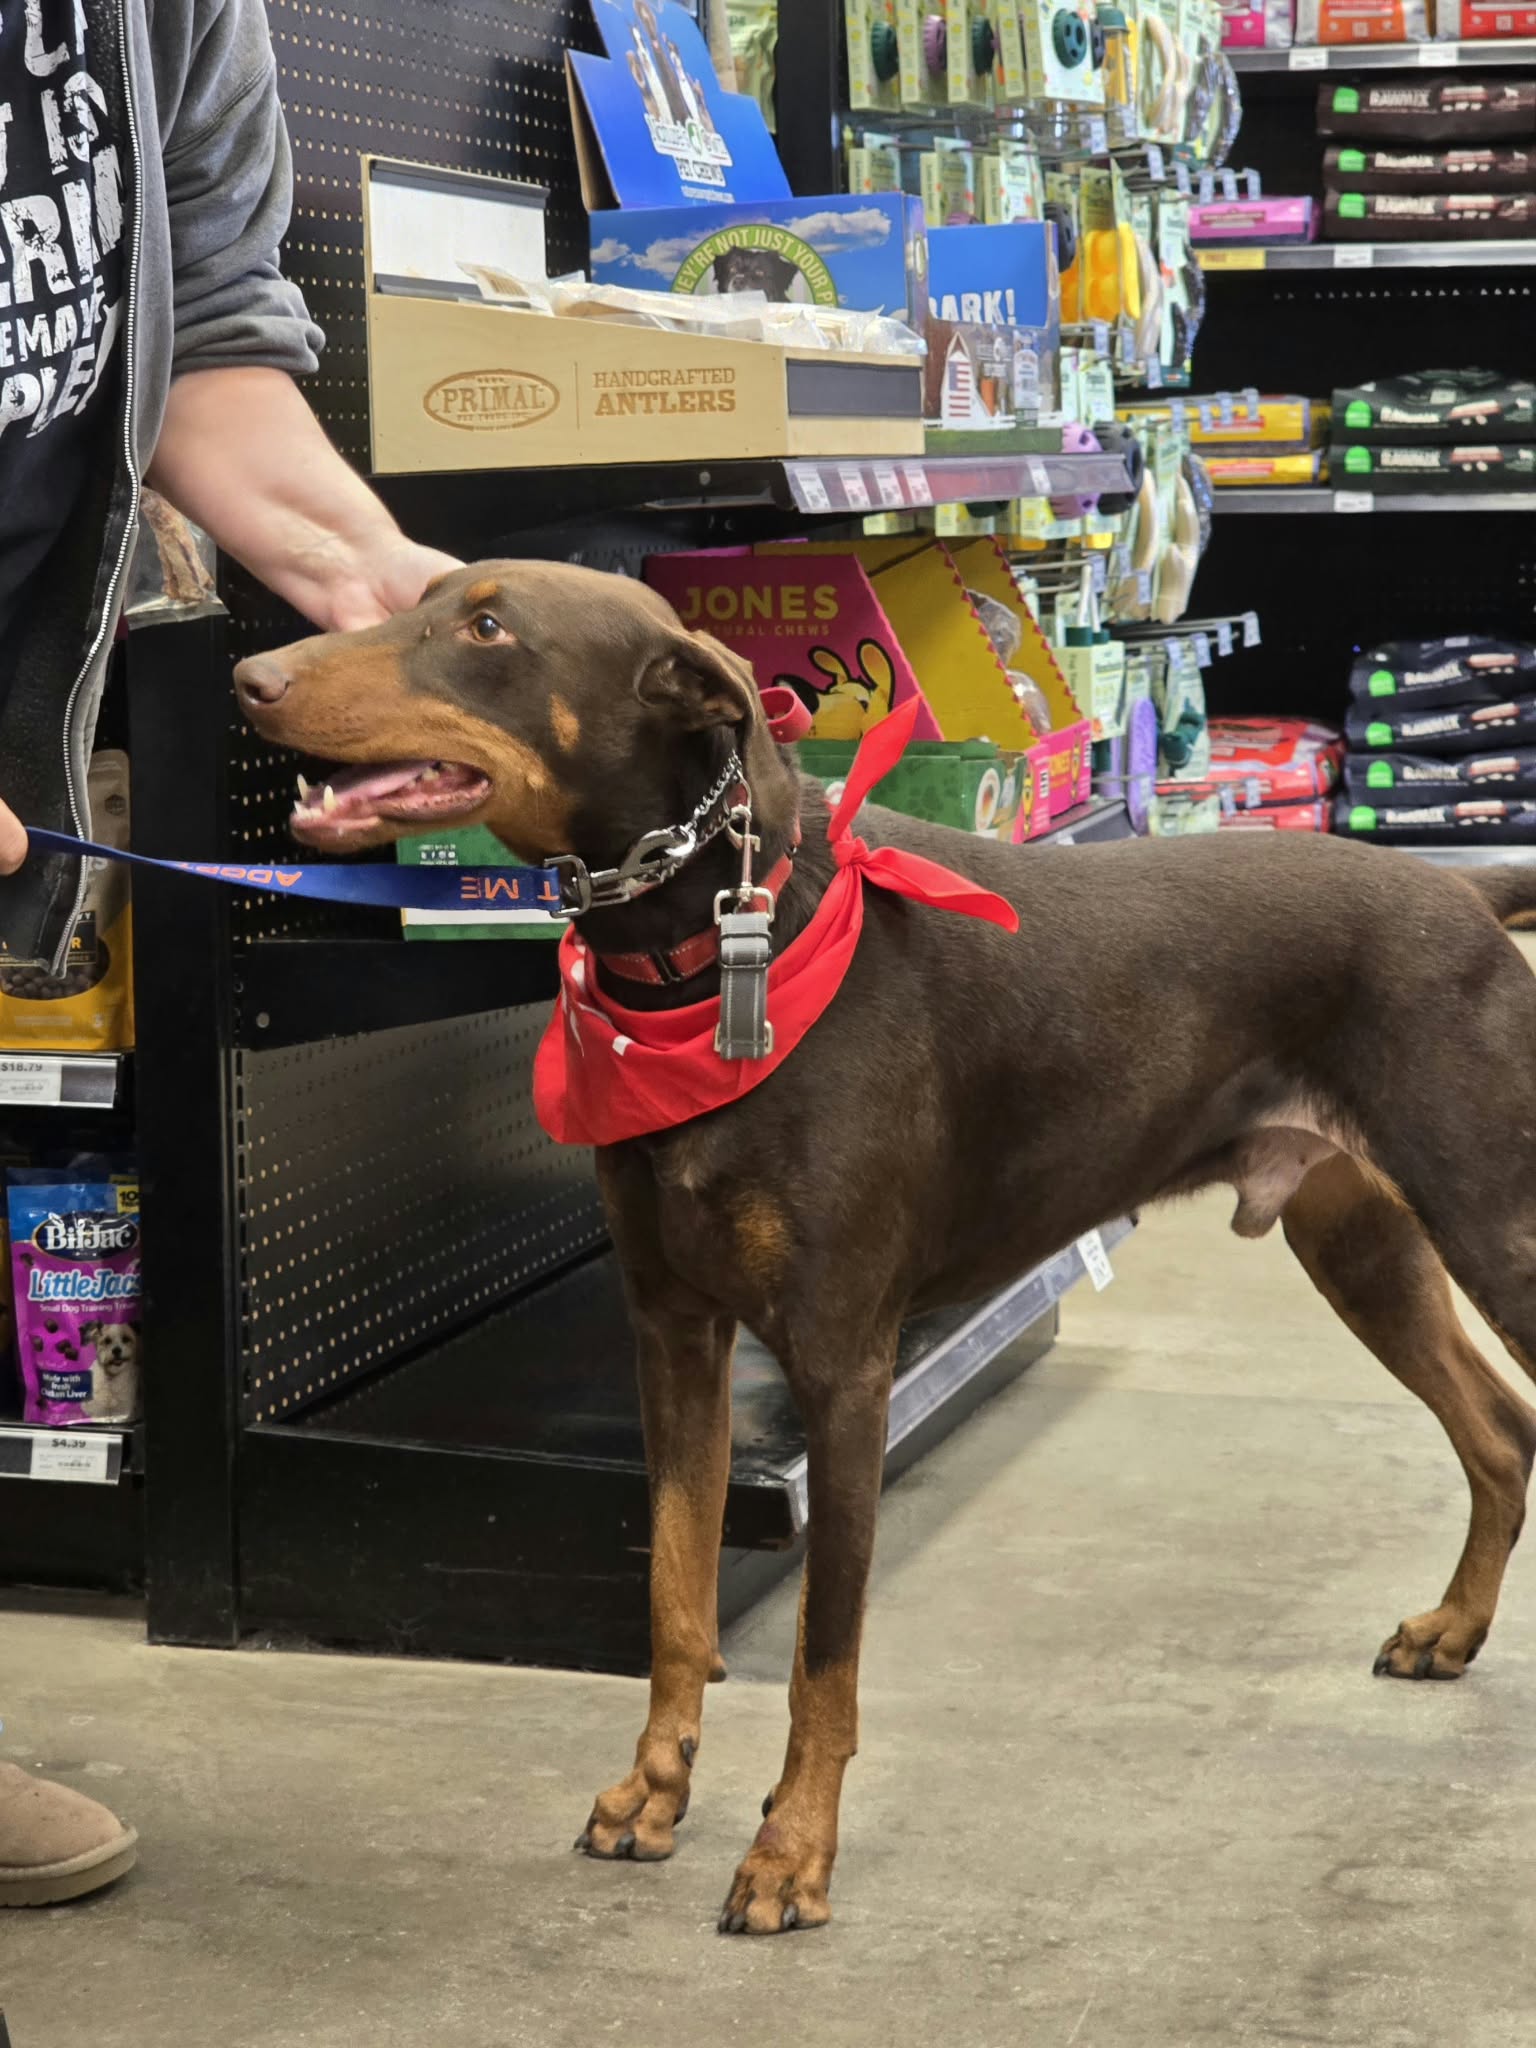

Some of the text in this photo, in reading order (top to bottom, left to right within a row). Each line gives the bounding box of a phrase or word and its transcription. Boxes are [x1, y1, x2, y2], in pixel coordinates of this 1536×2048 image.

[715, 229, 749, 254] NOT
[753, 229, 794, 254] JUST
[792, 244, 828, 289] YOUR
[593, 368, 737, 388] HANDCRAFTED
[442, 384, 546, 414] PRIMAL
[594, 390, 738, 416] ANTLERS
[681, 584, 839, 621] JONES
[775, 625, 830, 637] CHEWS
[460, 876, 519, 900] ME
[1, 1063, 43, 1072] $18.79
[62, 1304, 80, 1314] Dog
[52, 1439, 86, 1448] $4.39
